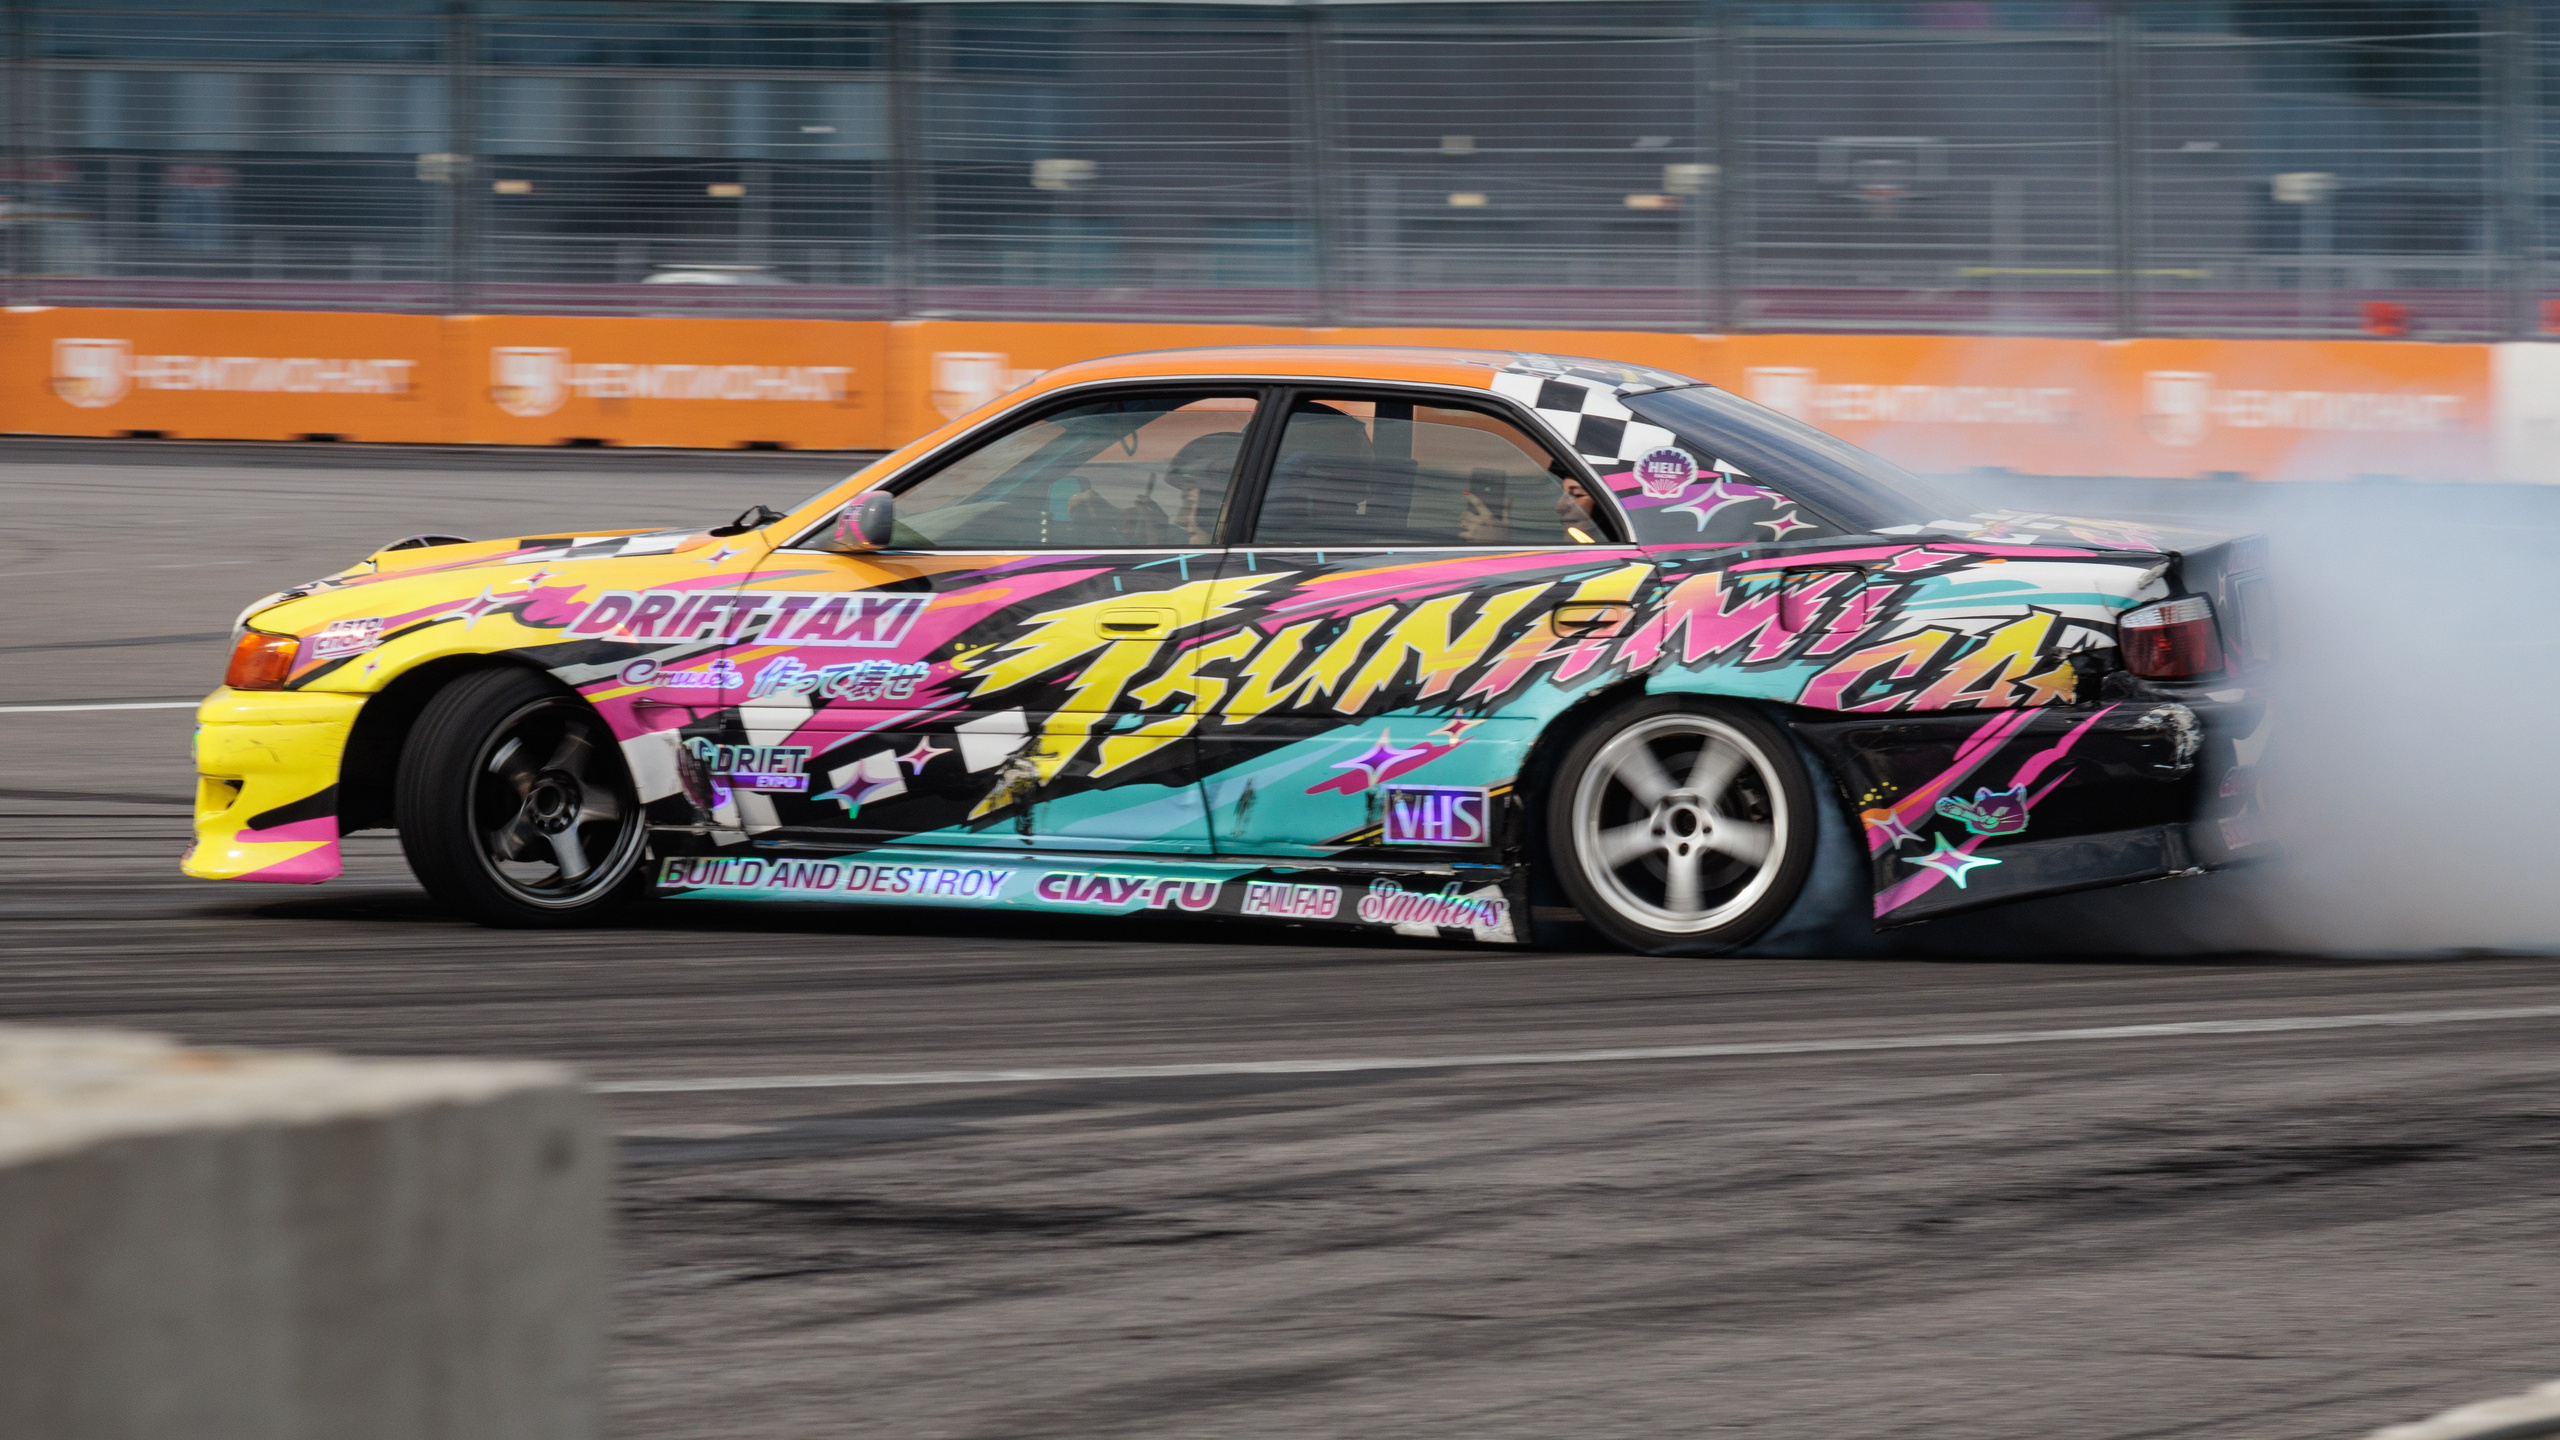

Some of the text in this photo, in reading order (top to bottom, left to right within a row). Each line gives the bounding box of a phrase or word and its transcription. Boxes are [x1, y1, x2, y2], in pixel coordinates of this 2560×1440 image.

[1647, 461, 1685, 475] HELL
[751, 658, 928, 699] 作って壊せ
[716, 747, 807, 773] DRIFT
[1393, 794, 1482, 841] VHS
[665, 858, 1009, 897] BUILD AND DESTROY
[1361, 877, 1505, 928] Smokers
